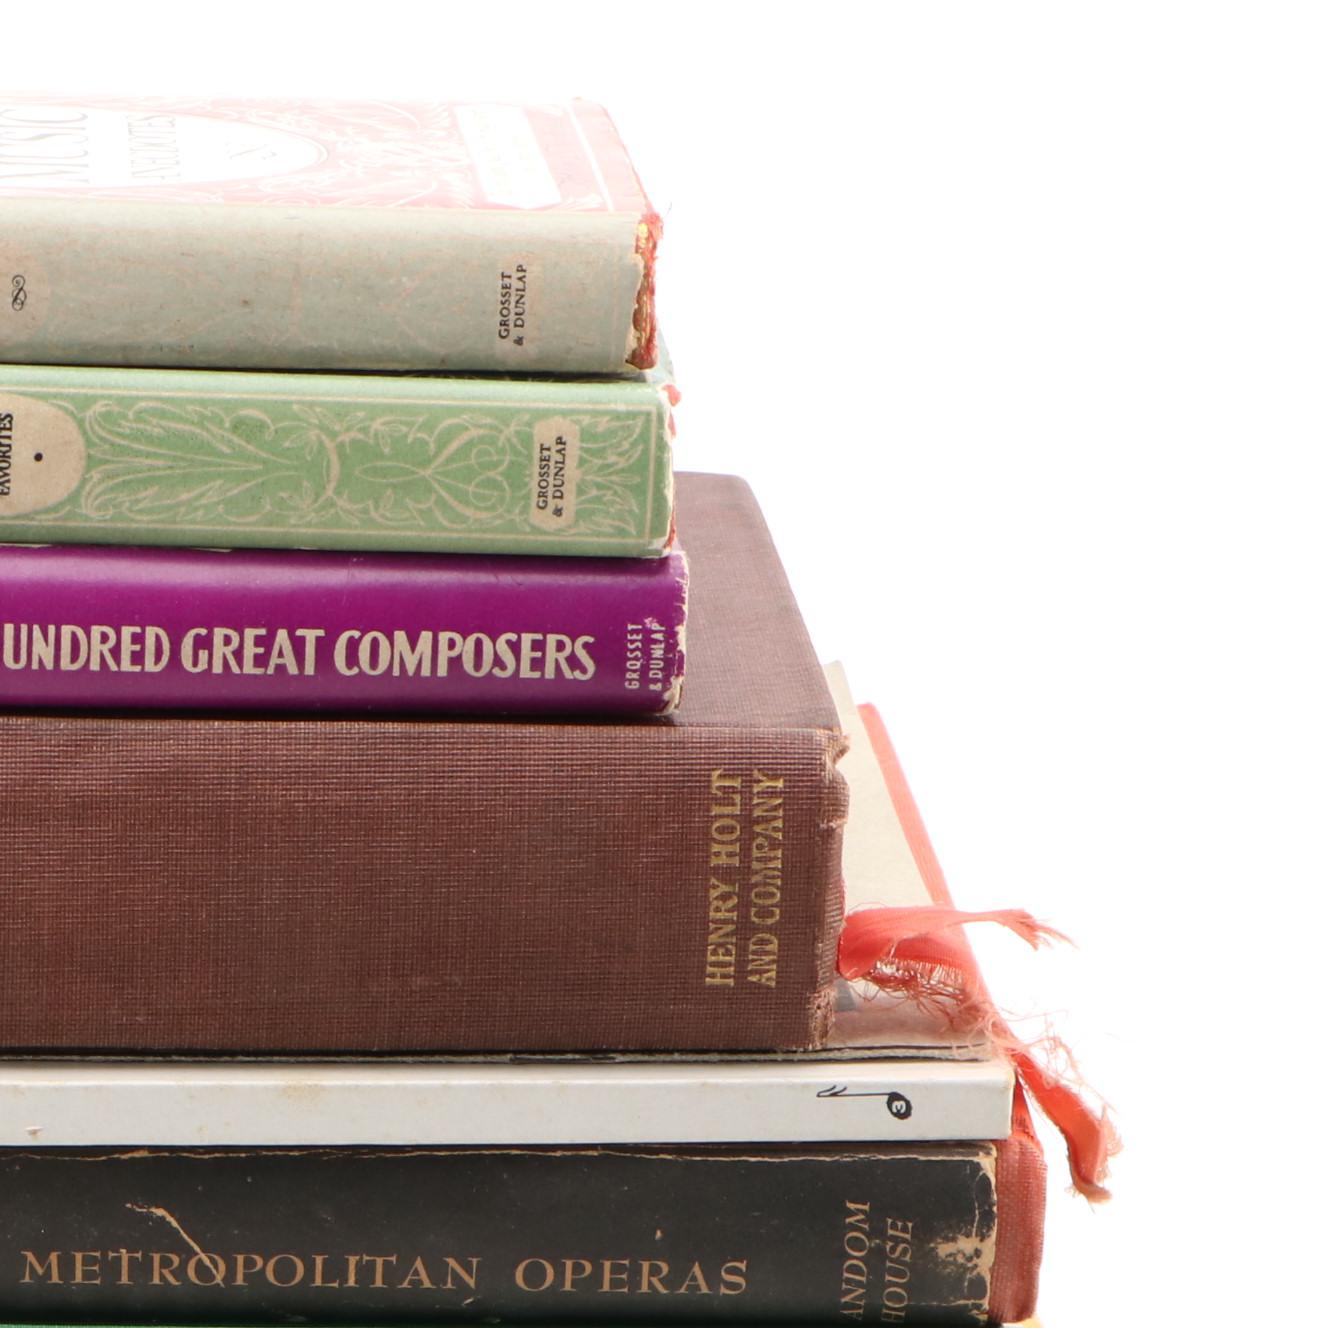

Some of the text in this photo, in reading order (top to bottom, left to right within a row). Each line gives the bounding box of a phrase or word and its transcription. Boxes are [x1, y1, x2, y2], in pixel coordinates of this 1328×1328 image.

[498, 272, 511, 339] GROSSET
[513, 264, 527, 346] & DUNLAP
[537, 444, 551, 510] GROSSET
[552, 436, 566, 517] & DUNLAP
[180, 627, 326, 676] GREAT
[334, 630, 596, 680] COMPOSERS
[625, 624, 642, 689] GROSSET
[649, 623, 665, 691] & DUNLAP
[705, 768, 742, 986] HENRY HOLT
[747, 768, 784, 988] AND COMPANY
[21, 1250, 482, 1290] METROPOLITAN
[515, 1257, 749, 1295] OPERAS
